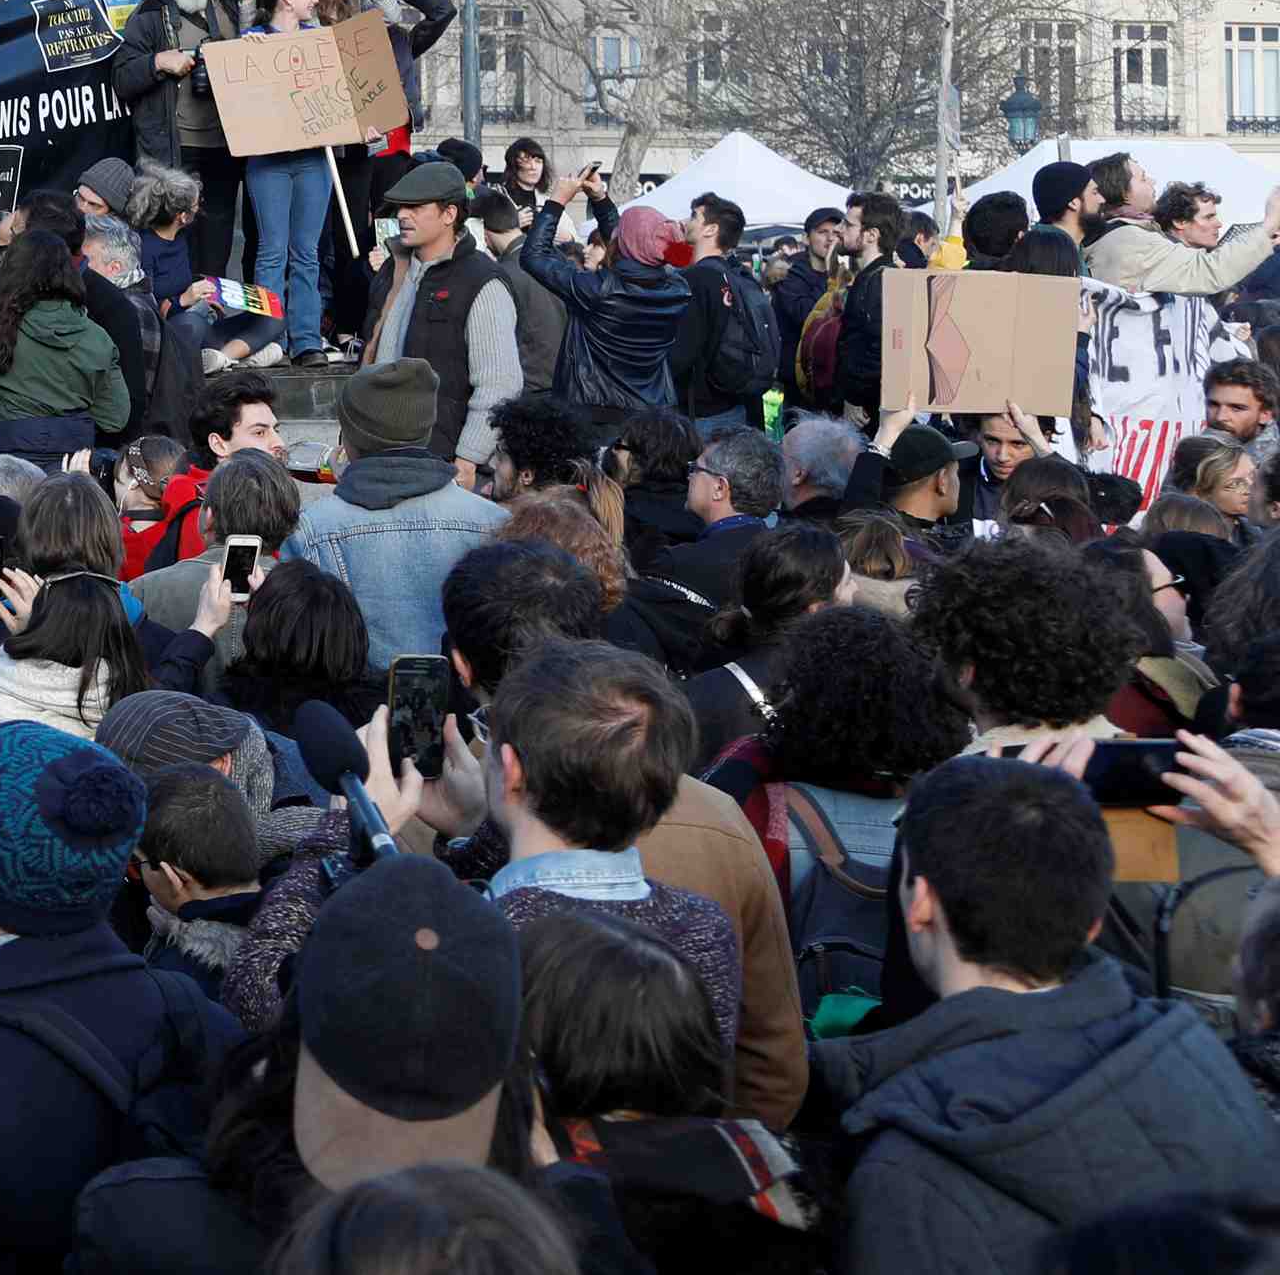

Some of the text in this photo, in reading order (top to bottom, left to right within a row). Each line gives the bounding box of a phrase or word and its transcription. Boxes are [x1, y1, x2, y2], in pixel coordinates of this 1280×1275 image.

[224, 53, 265, 85] LA
[294, 70, 329, 89] EST
[39, 85, 97, 132] POUR
[100, 82, 123, 121] LA
